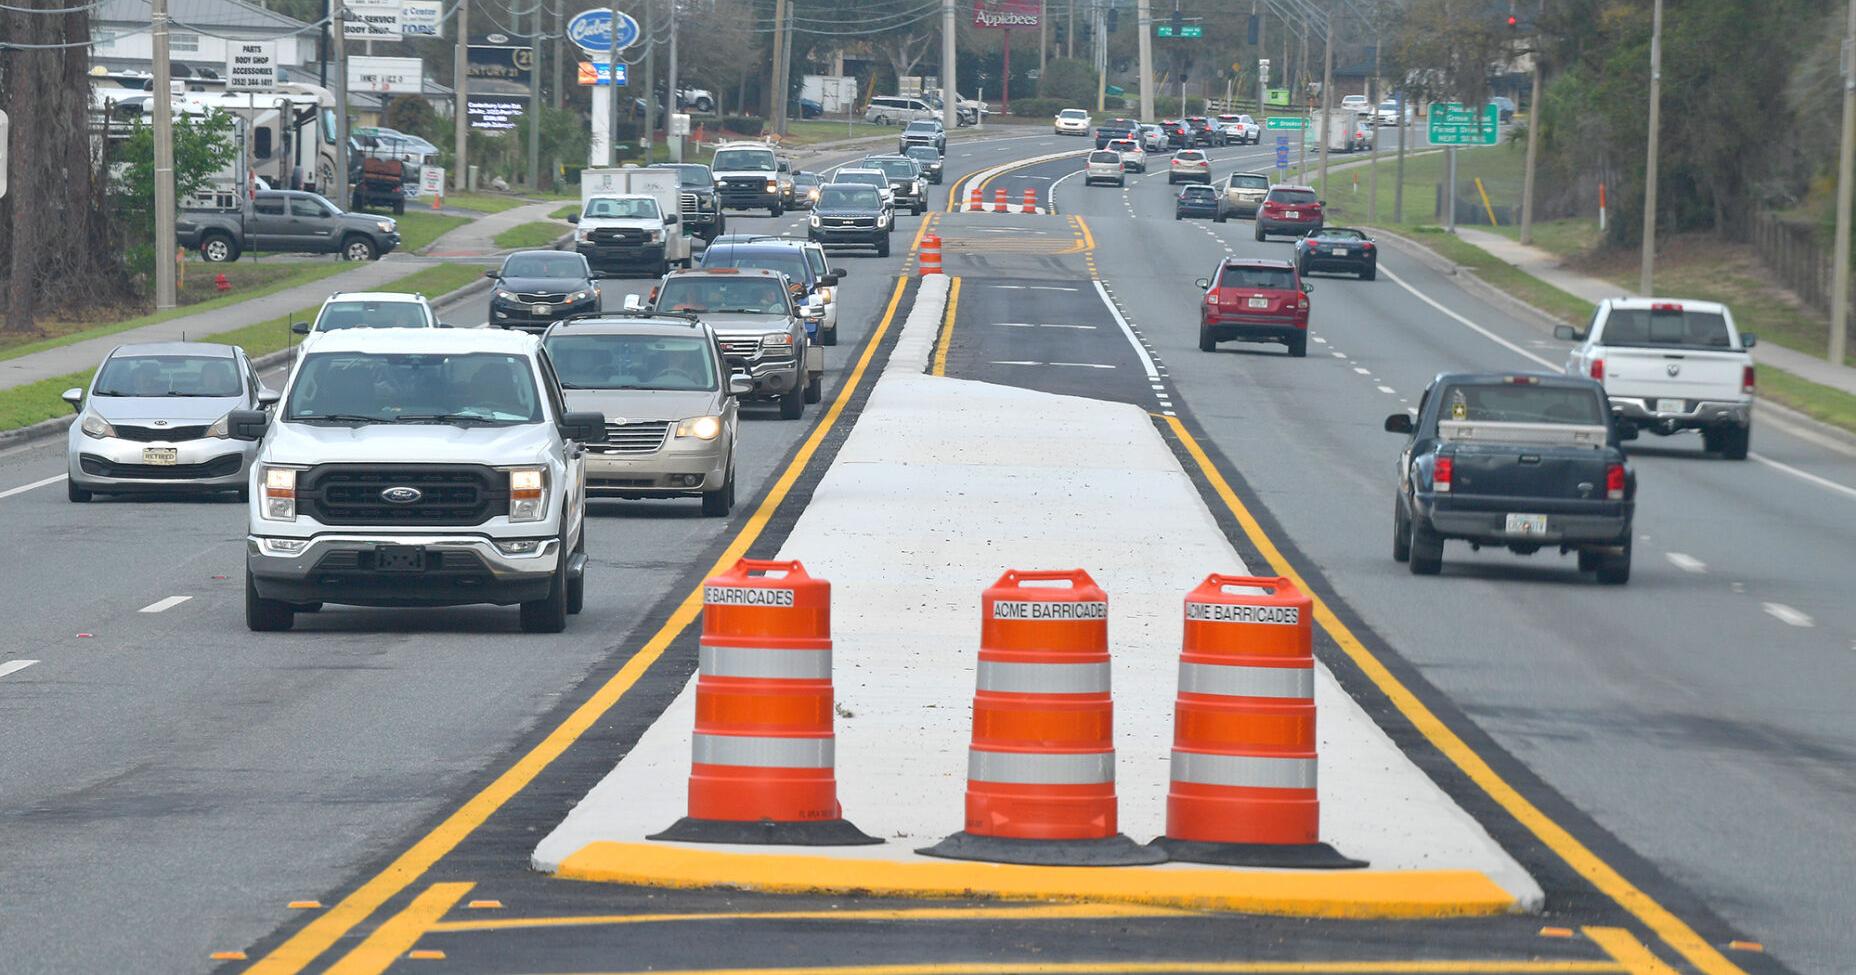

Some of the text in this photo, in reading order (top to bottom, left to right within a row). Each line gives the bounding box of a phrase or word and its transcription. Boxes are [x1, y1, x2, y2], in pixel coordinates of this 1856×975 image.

[243, 45, 262, 53] PARTS
[235, 56, 269, 64] BODY SHOP
[232, 67, 273, 75] ACCESSORIES
[713, 588, 793, 605] BARRICADES
[995, 602, 1028, 618] ACME
[1215, 605, 1298, 624] BARRICADES
